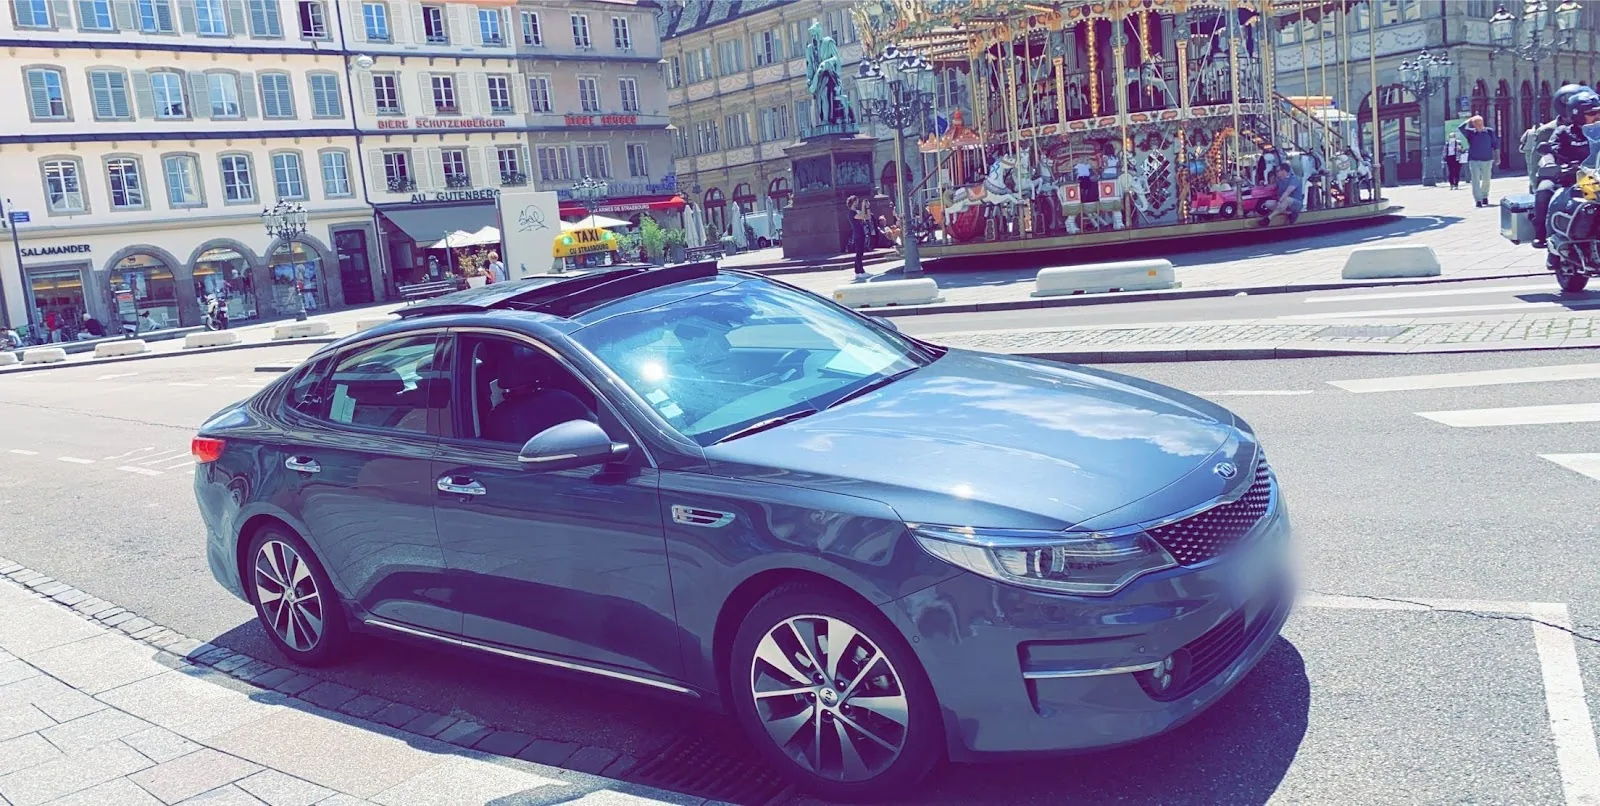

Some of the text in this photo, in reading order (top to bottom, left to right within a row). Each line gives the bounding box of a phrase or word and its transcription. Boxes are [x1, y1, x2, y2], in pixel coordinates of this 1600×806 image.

[411, 193, 426, 203] AU
[574, 228, 600, 243] TAXI
[21, 244, 91, 257] SALAMANDER
[578, 243, 609, 254] STRASBOURG
